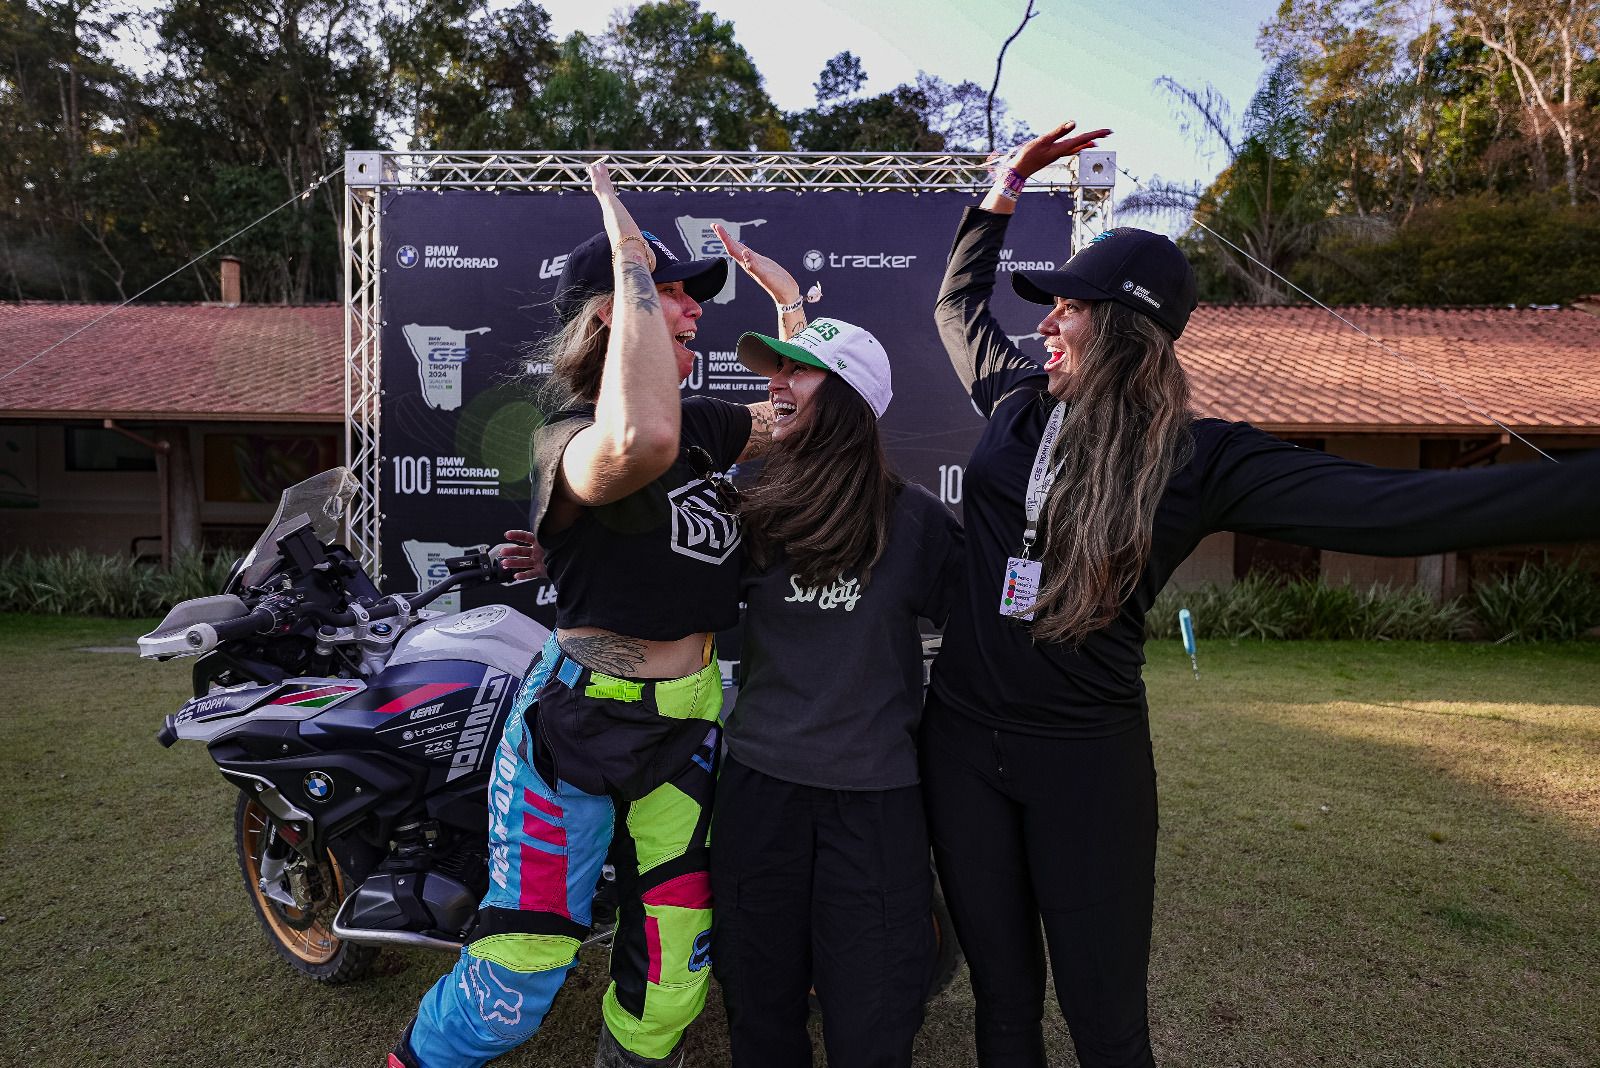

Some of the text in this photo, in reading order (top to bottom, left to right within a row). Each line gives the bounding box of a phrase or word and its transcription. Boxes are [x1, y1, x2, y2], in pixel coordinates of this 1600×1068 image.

[425, 245, 458, 257] BMW
[424, 257, 499, 269] MOTORRAD
[829, 252, 917, 268] tracker
[996, 261, 1055, 272] TORRAD
[708, 351, 738, 361] BMW
[436, 456, 465, 467] BMW
[393, 455, 431, 495] 100
[436, 467, 500, 478] MOTORRAD
[938, 464, 963, 504] 10
[436, 487, 500, 496] MAKE LIFE A RIDE
[196, 696, 231, 714] TROPHY
[413, 720, 459, 738] tracker
